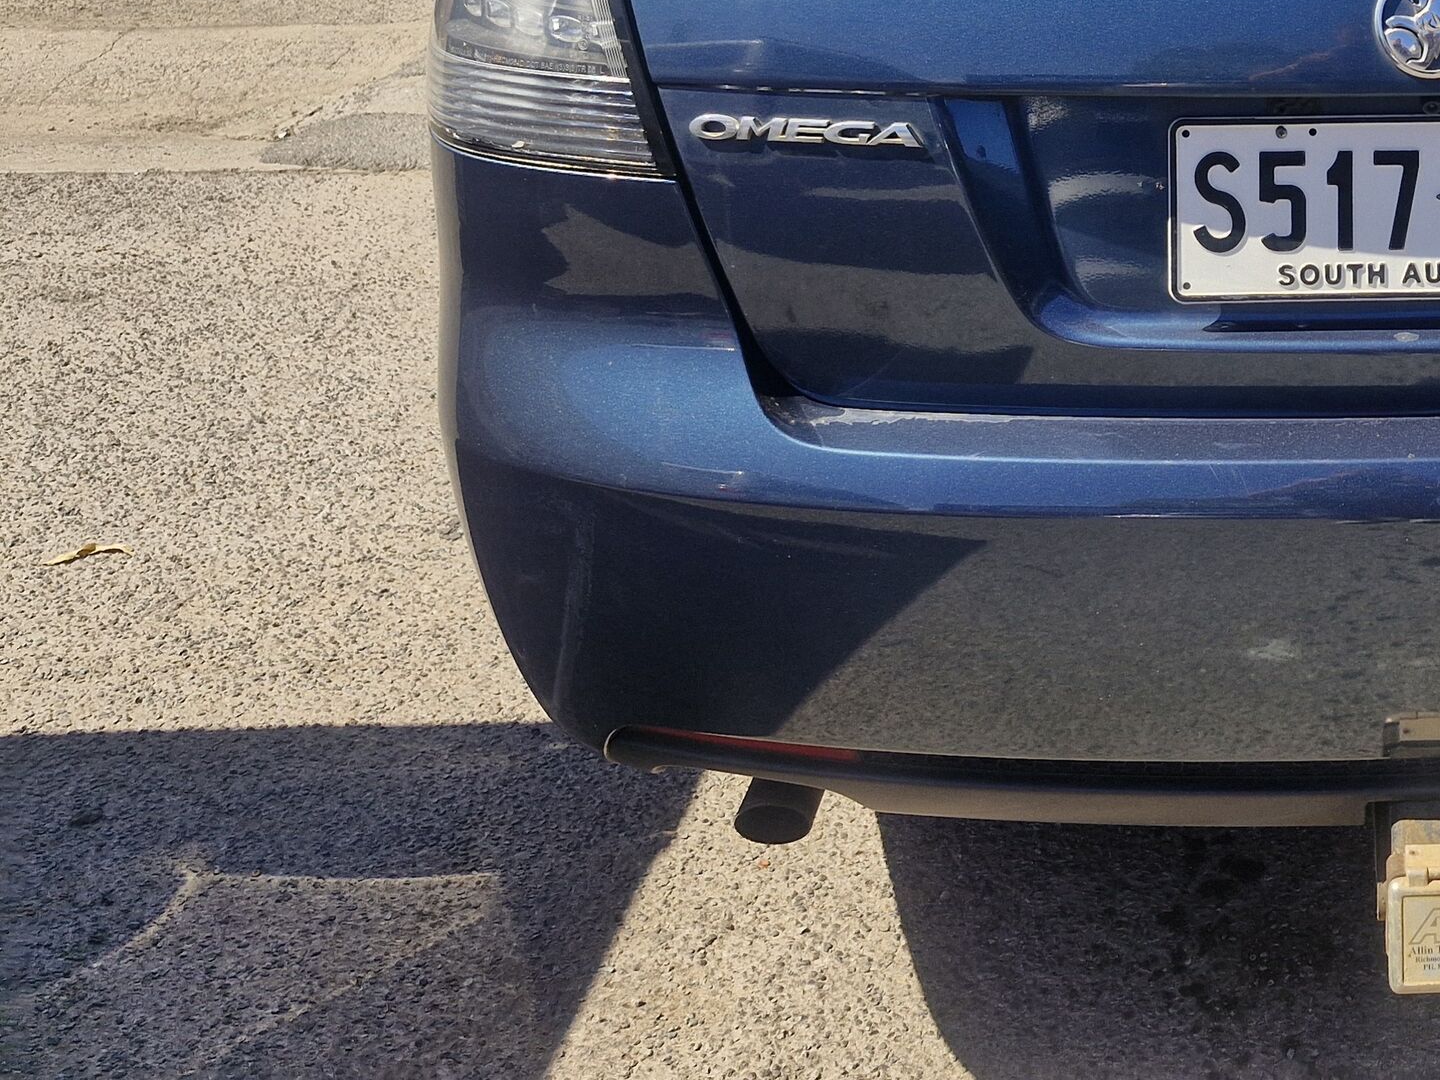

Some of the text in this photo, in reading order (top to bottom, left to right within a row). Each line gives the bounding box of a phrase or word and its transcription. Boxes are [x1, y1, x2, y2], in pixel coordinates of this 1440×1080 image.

[689, 113, 924, 148] OMEGA
[1278, 262, 1387, 287] SOUTH
[1411, 945, 1433, 955] Allin
